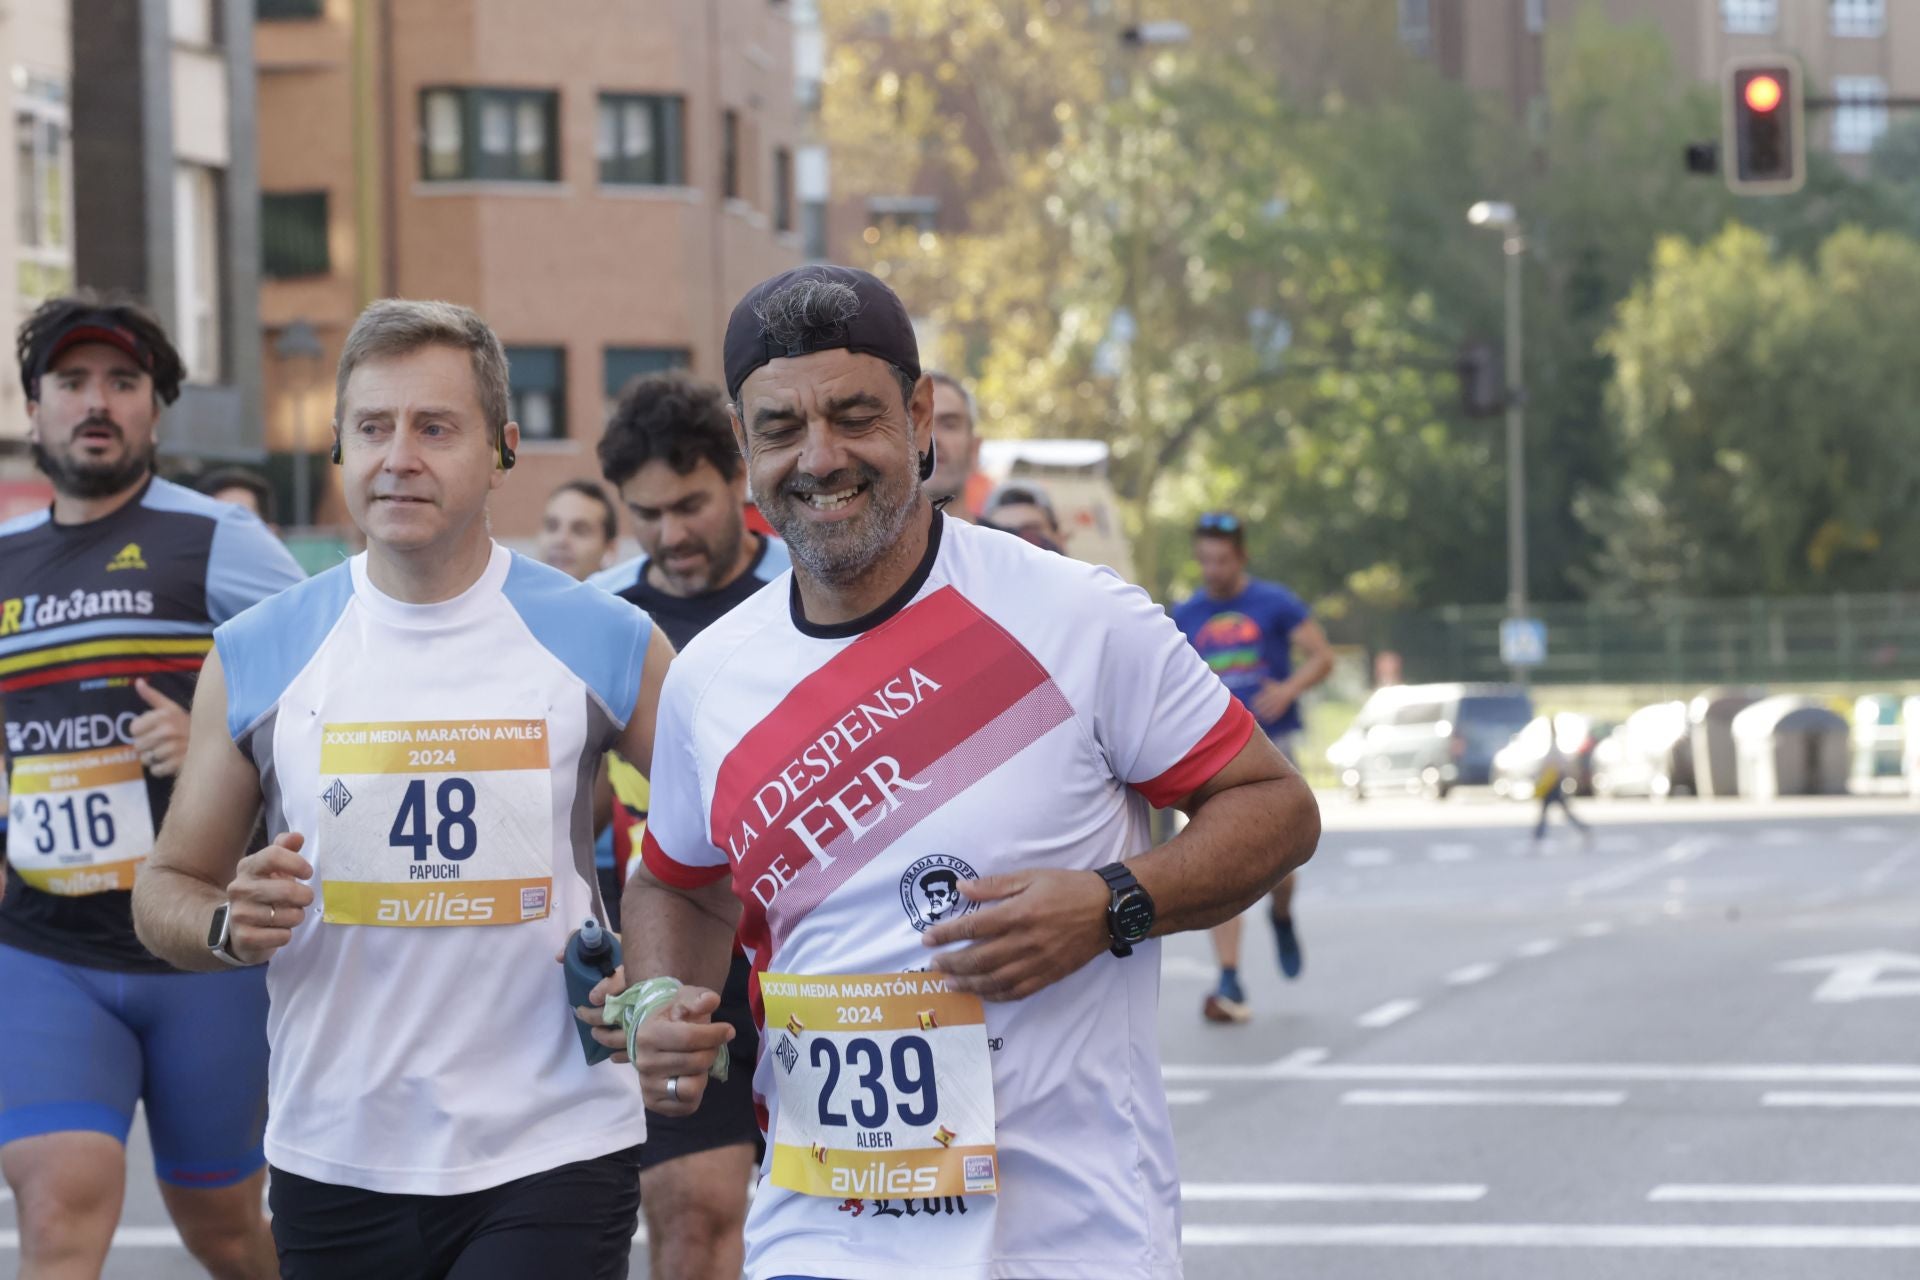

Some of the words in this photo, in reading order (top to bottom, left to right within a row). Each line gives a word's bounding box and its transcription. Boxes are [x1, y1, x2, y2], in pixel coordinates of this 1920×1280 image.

[0, 589, 154, 635] RIdr3ams
[325, 730, 367, 745] XXXIII
[369, 728, 413, 743] MEDIA
[415, 723, 492, 742] MARATÓN
[493, 722, 543, 741] AVILÉS
[408, 749, 457, 766] 2024
[728, 820, 759, 866] LA
[753, 667, 942, 828] DESPENSA
[33, 791, 116, 855] 316
[388, 777, 478, 861] 48
[750, 855, 798, 911] DE
[784, 755, 933, 873] FER
[409, 863, 460, 880] PAPUCHI
[903, 858, 934, 885] PRADA
[936, 856, 945, 865] A
[948, 858, 976, 880] TOPE
[376, 892, 496, 922] avilés
[763, 981, 799, 997] XXXIII
[800, 983, 838, 998] MEDIA
[840, 977, 918, 997] MARATÓN
[920, 979, 953, 995] AVI
[836, 1006, 883, 1024] 2024
[810, 1035, 939, 1129] 239
[856, 1131, 893, 1148] ALBER
[831, 1161, 939, 1194] avilés
